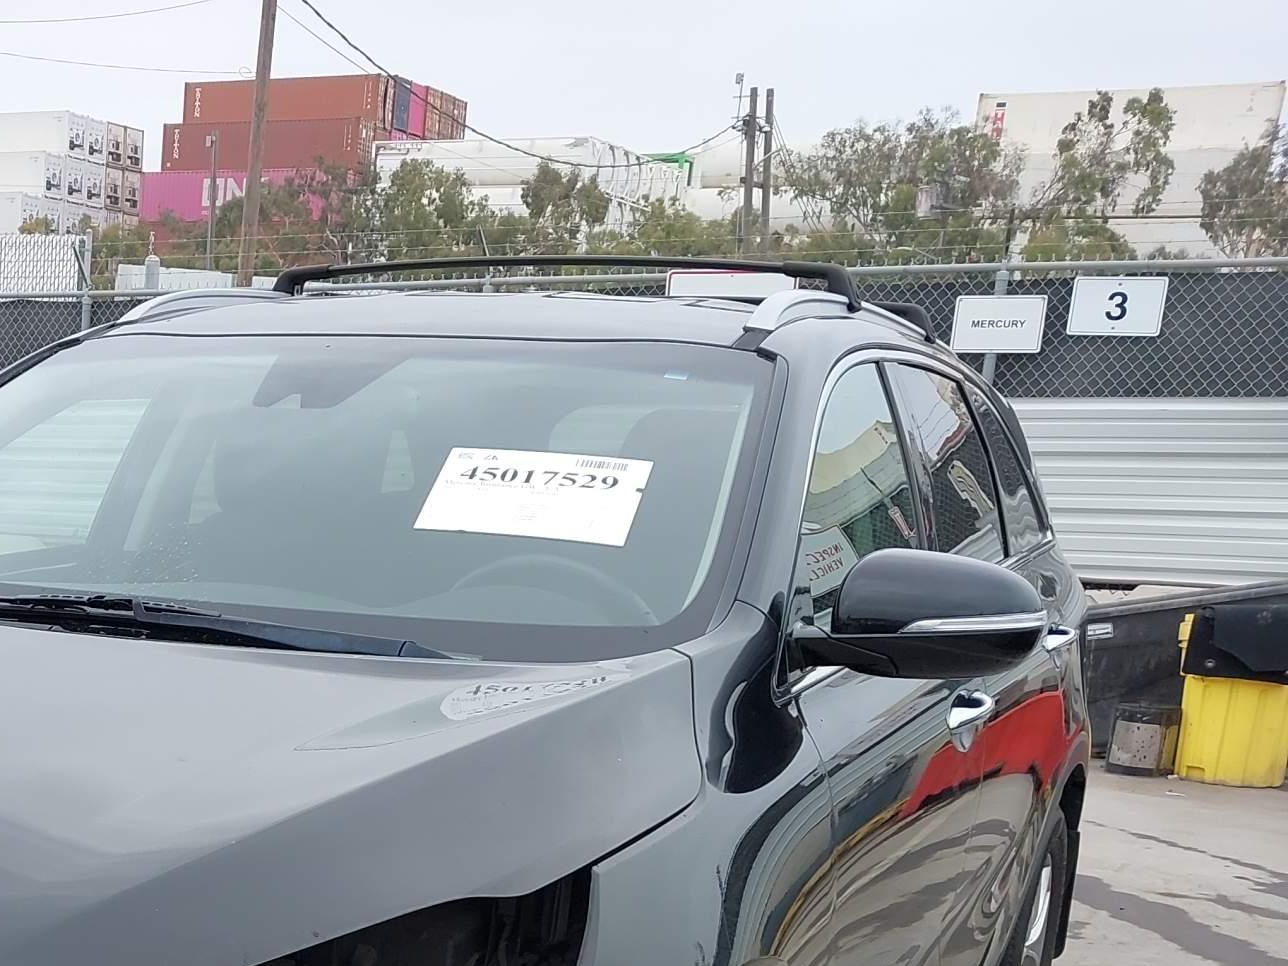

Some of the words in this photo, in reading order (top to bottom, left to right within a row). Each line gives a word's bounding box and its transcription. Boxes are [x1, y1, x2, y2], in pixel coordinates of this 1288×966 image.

[201, 177, 269, 207] ON
[1105, 291, 1129, 321] 3
[970, 319, 1027, 329] MERCURY
[460, 466, 619, 490] 45017529
